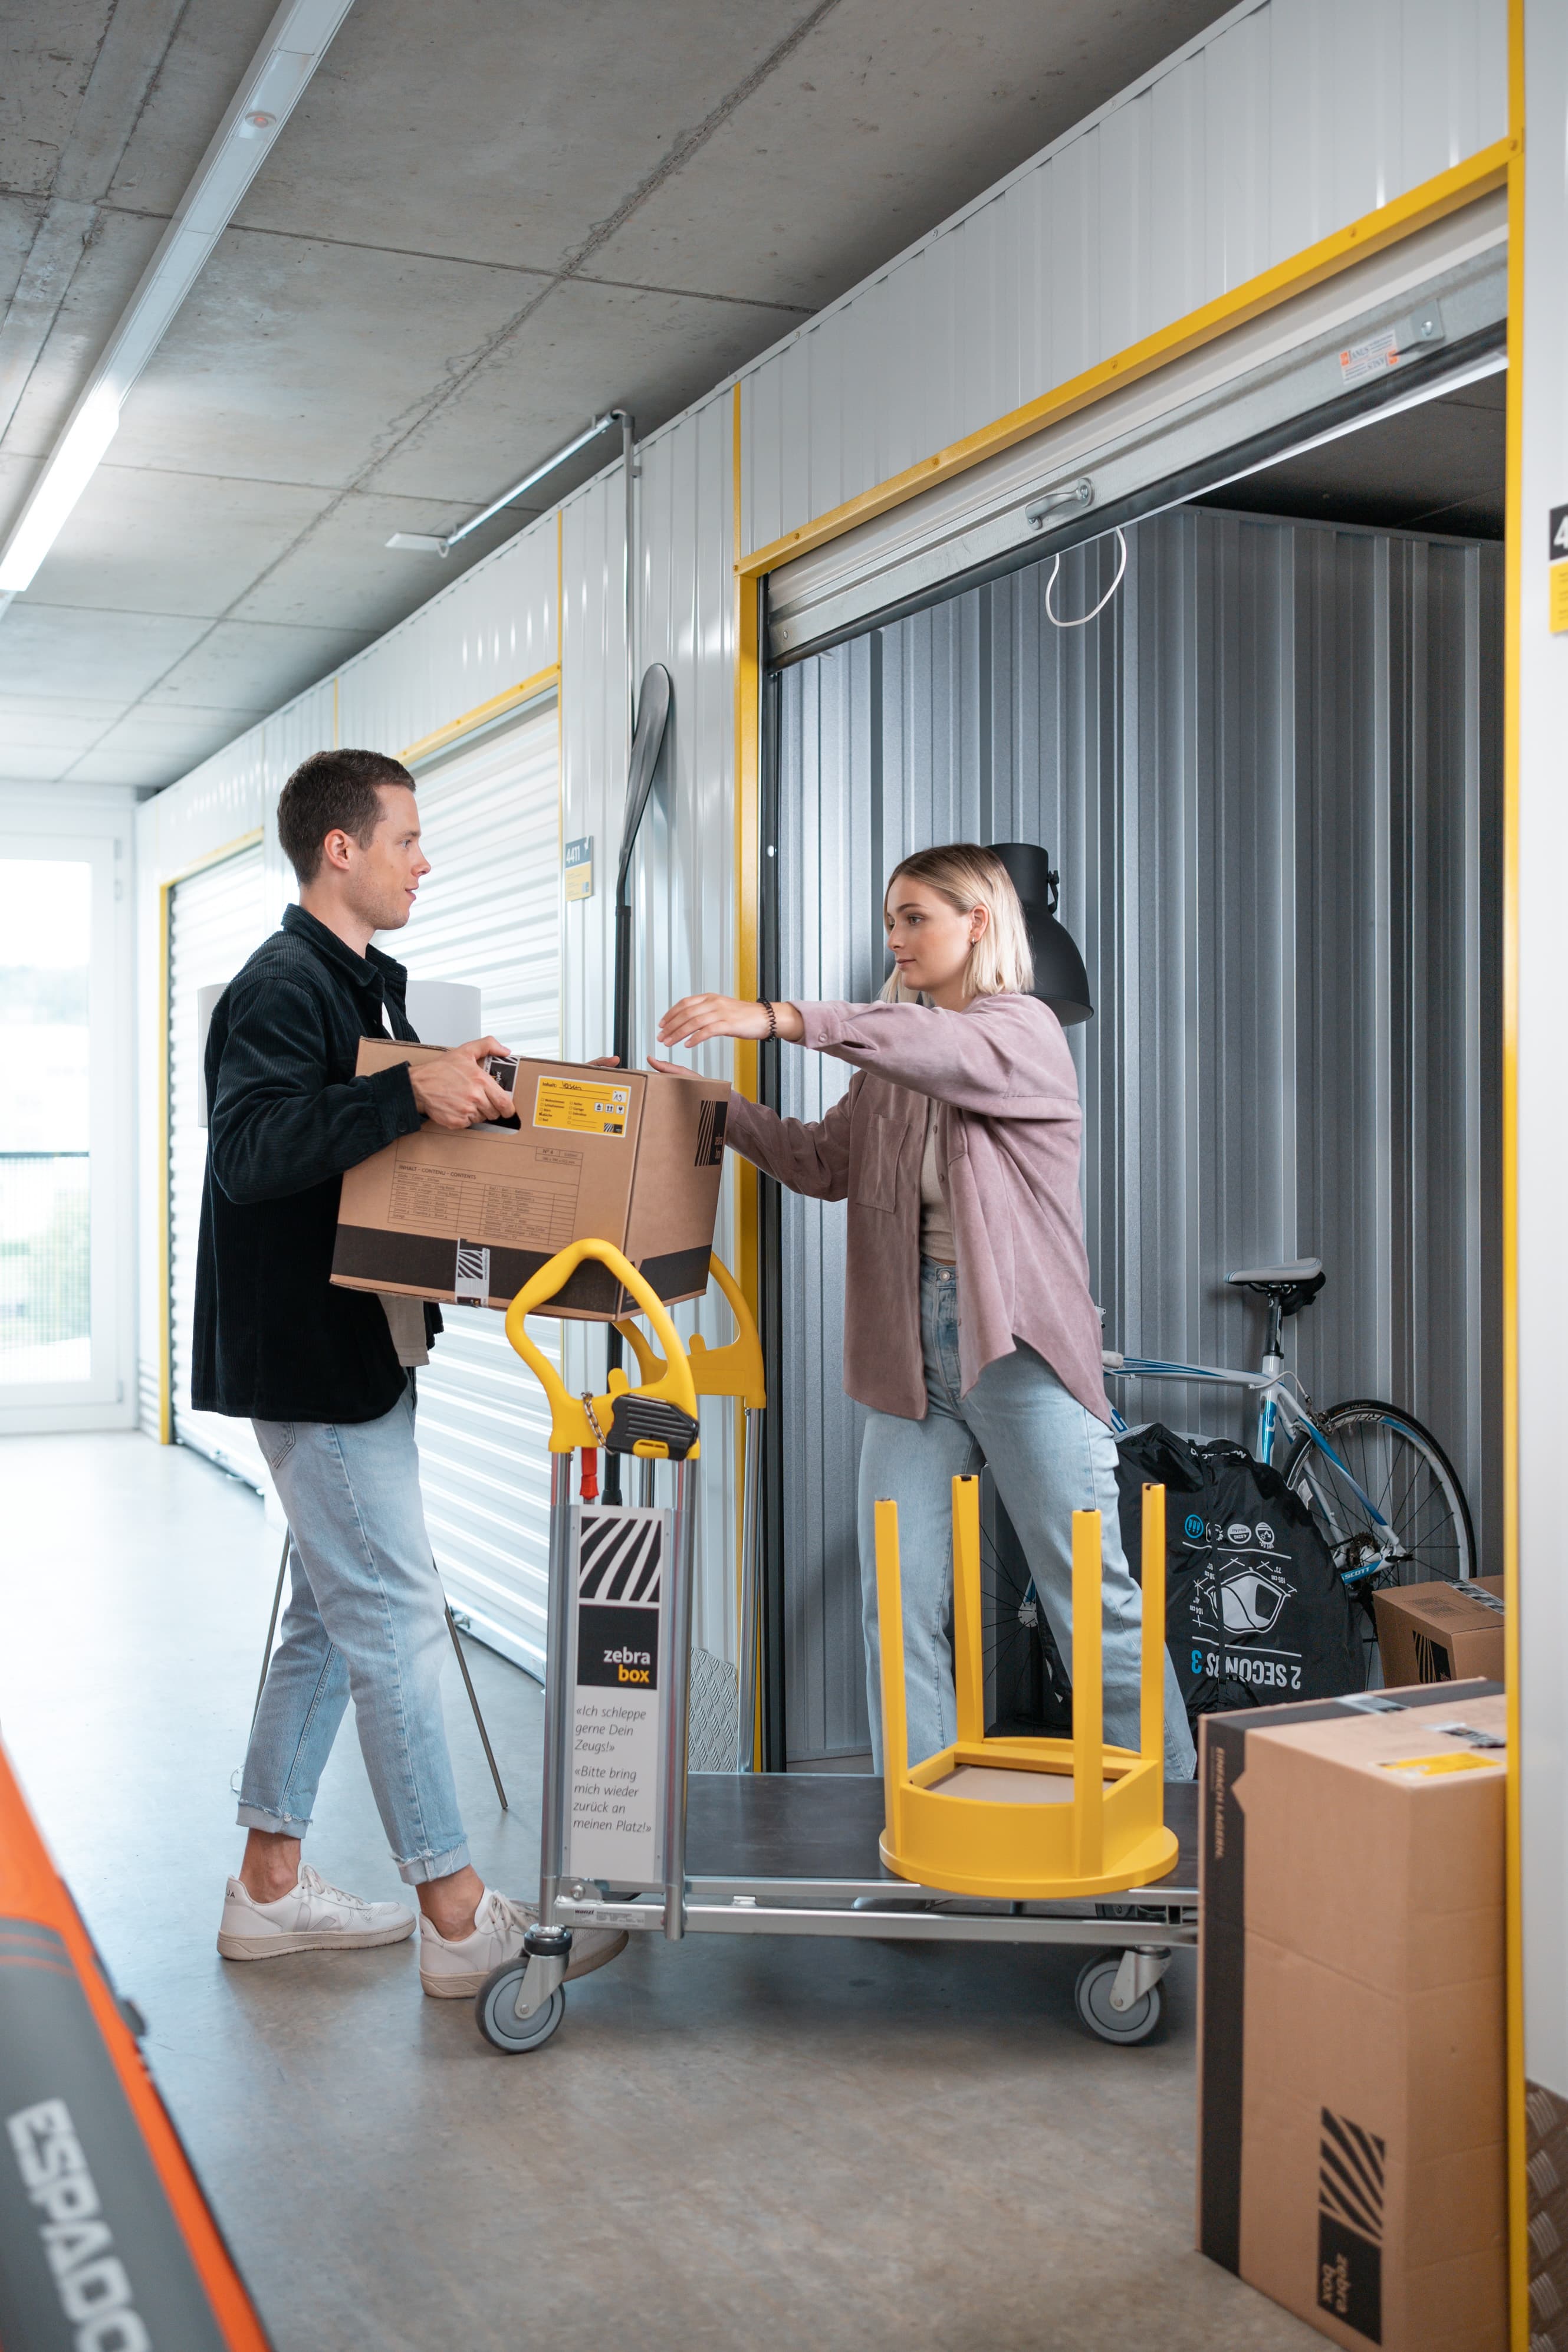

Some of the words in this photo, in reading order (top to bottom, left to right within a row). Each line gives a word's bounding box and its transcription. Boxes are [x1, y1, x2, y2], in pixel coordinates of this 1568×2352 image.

[450, 1171, 476, 1180] CONTENTS
[1345, 1566, 1369, 1579] SCOTT
[603, 1646, 650, 1665] zebra
[1191, 1650, 1202, 1674] 3
[618, 1664, 650, 1683] box
[1291, 1666, 1301, 1689] 2
[576, 1704, 598, 1717] «Ich
[601, 1706, 646, 1722] schleppe
[576, 1724, 606, 1736] gerne
[609, 1724, 633, 1736] Dein
[574, 1739, 615, 1755] Zeugs!»
[575, 1765, 606, 1778] «Bitte
[609, 1767, 637, 1783] bring
[574, 1783, 600, 1795] mich
[604, 1785, 639, 1797] wieder
[573, 1801, 609, 1812] zurück
[612, 1805, 626, 1814] an
[573, 1818, 612, 1830] meinen
[616, 1820, 652, 1832] Platz!»
[1322, 2263, 1337, 2303] box
[1335, 2252, 1350, 2313] zebra
